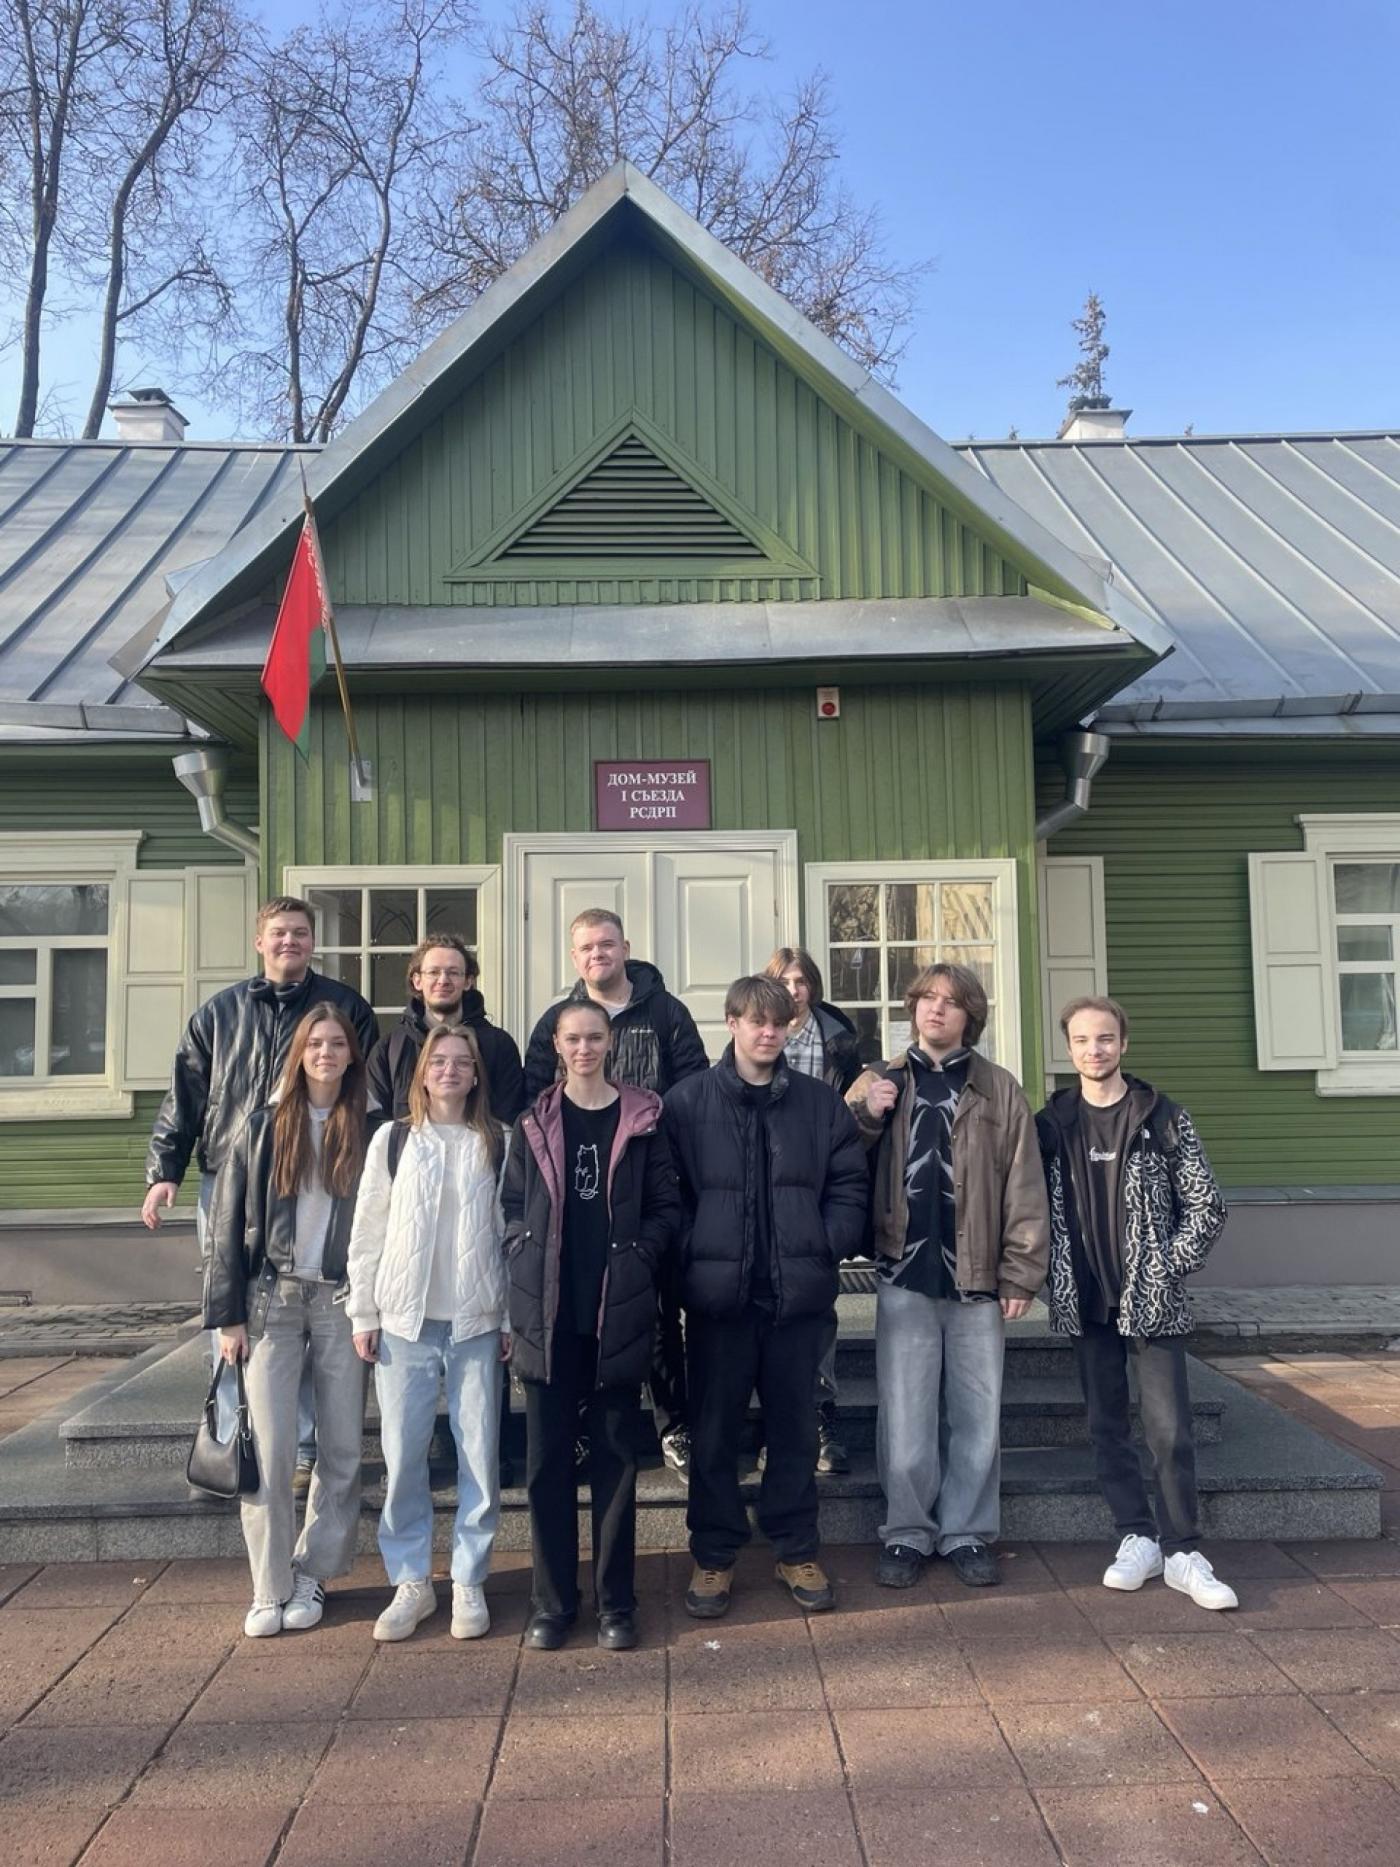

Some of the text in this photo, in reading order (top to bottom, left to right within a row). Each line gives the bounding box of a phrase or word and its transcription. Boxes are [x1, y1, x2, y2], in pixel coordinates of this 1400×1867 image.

[607, 770, 697, 787] ДОМ-МУЗЕЙ
[631, 790, 685, 803] СЪЕЗДА
[630, 806, 677, 820] РСДРП
